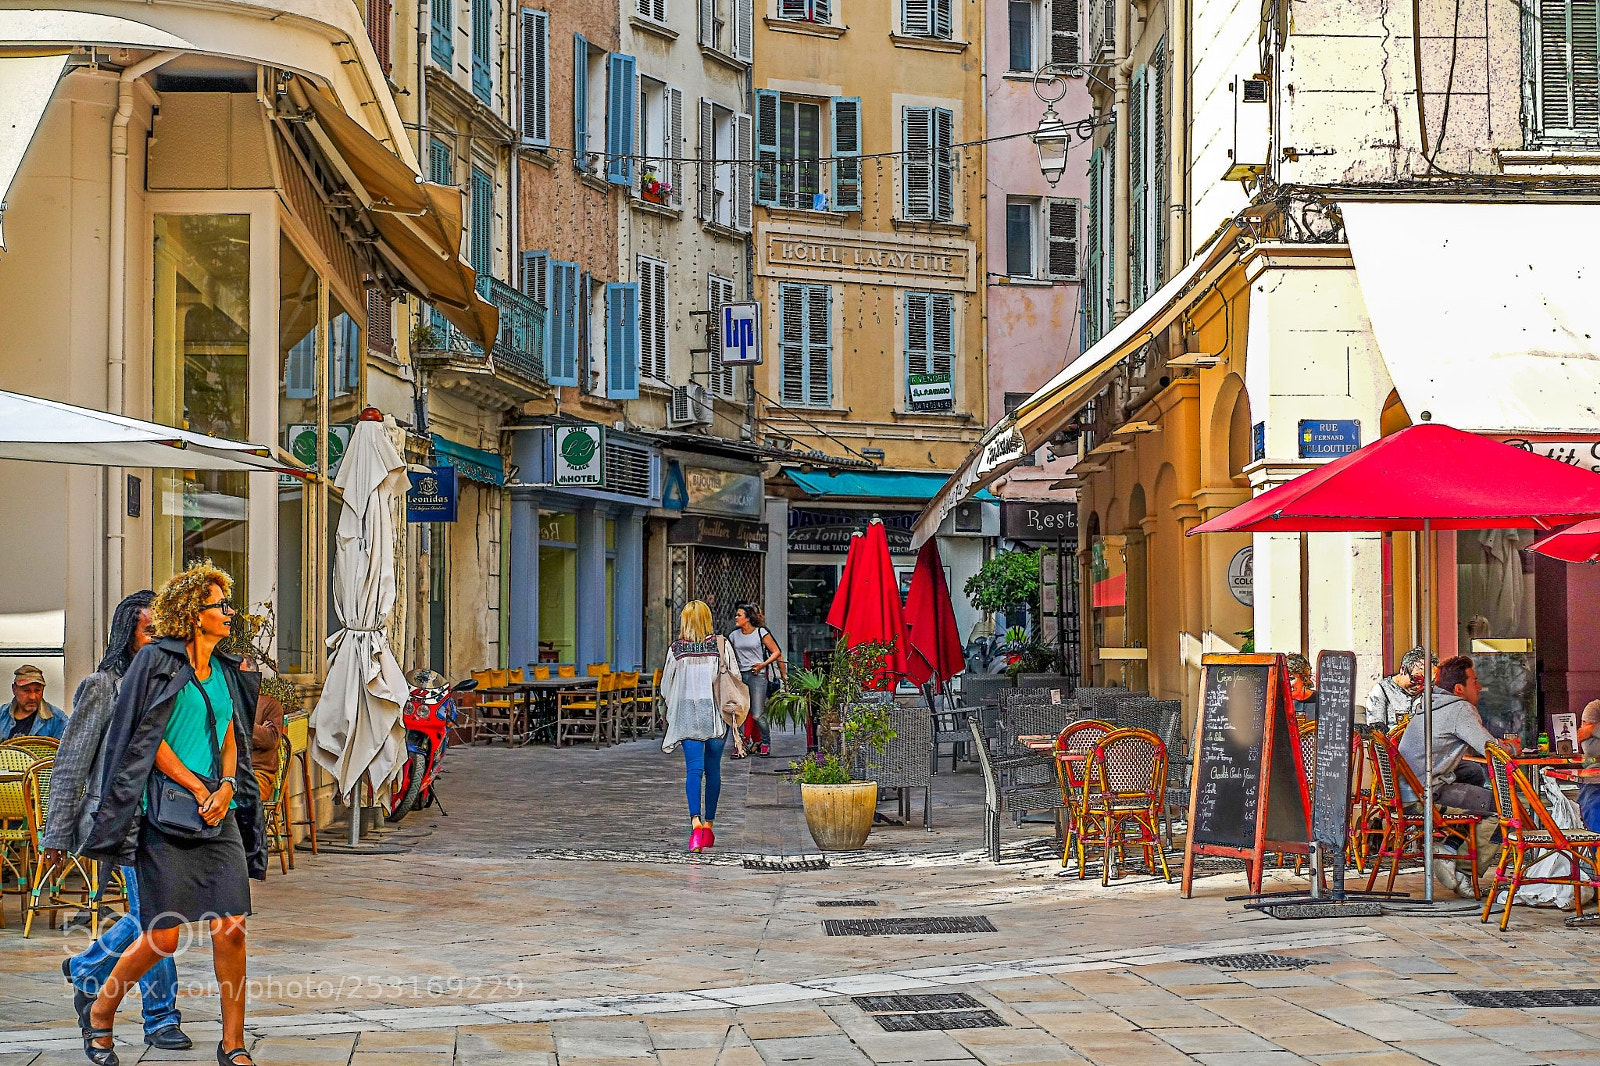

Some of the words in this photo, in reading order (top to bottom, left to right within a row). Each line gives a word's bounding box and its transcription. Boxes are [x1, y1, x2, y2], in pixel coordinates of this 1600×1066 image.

[854, 249, 952, 272] LAFAYETTE
[1319, 423, 1338, 432] RUE
[566, 463, 590, 471] PALACE
[567, 475, 598, 483] HOTEL
[407, 494, 449, 504] Leonidas
[793, 543, 821, 551] ATELIER
